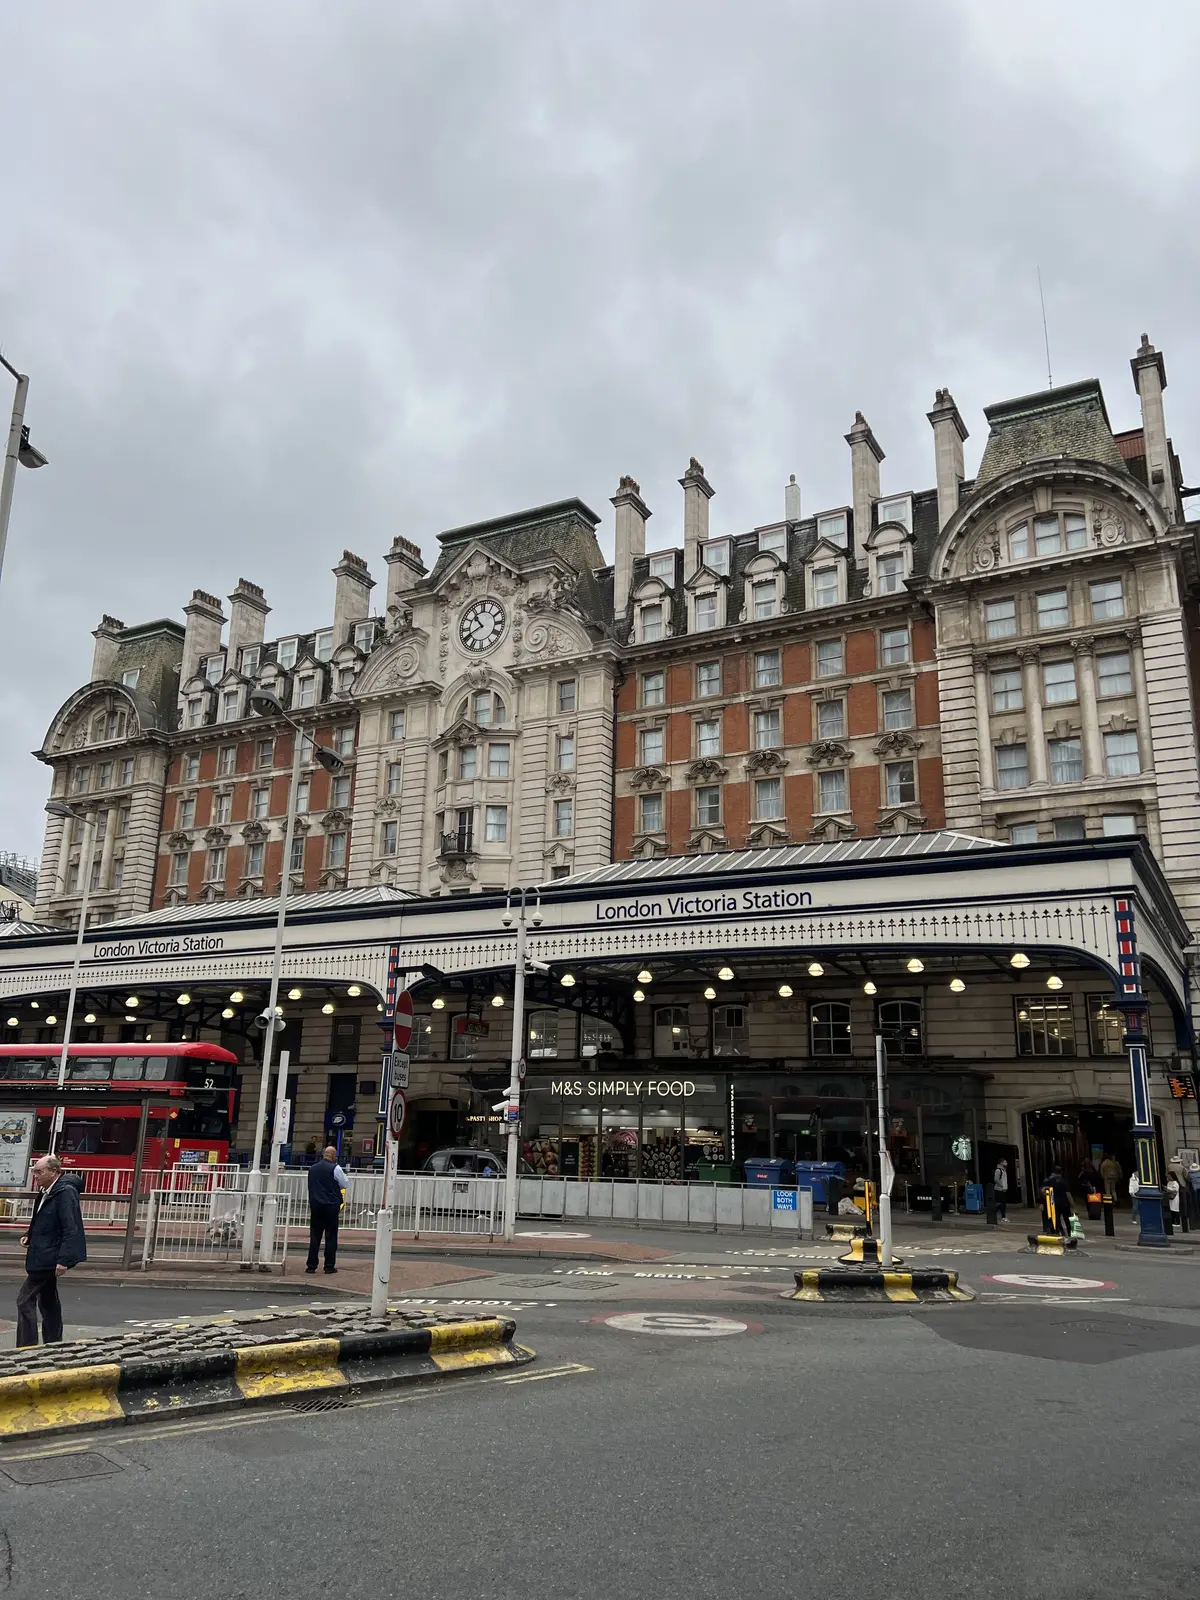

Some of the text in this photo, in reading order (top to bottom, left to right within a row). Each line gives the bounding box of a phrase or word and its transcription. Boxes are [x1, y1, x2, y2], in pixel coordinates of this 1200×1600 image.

[596, 889, 813, 920] London Victoria Station
[93, 935, 224, 958] London Victoria Station
[394, 1056, 408, 1069] Except
[204, 1078, 214, 1089] 52
[394, 1070, 407, 1082] buses
[551, 1081, 696, 1097] M&S SIMPLY FOOD
[394, 1103, 403, 1123] 10
